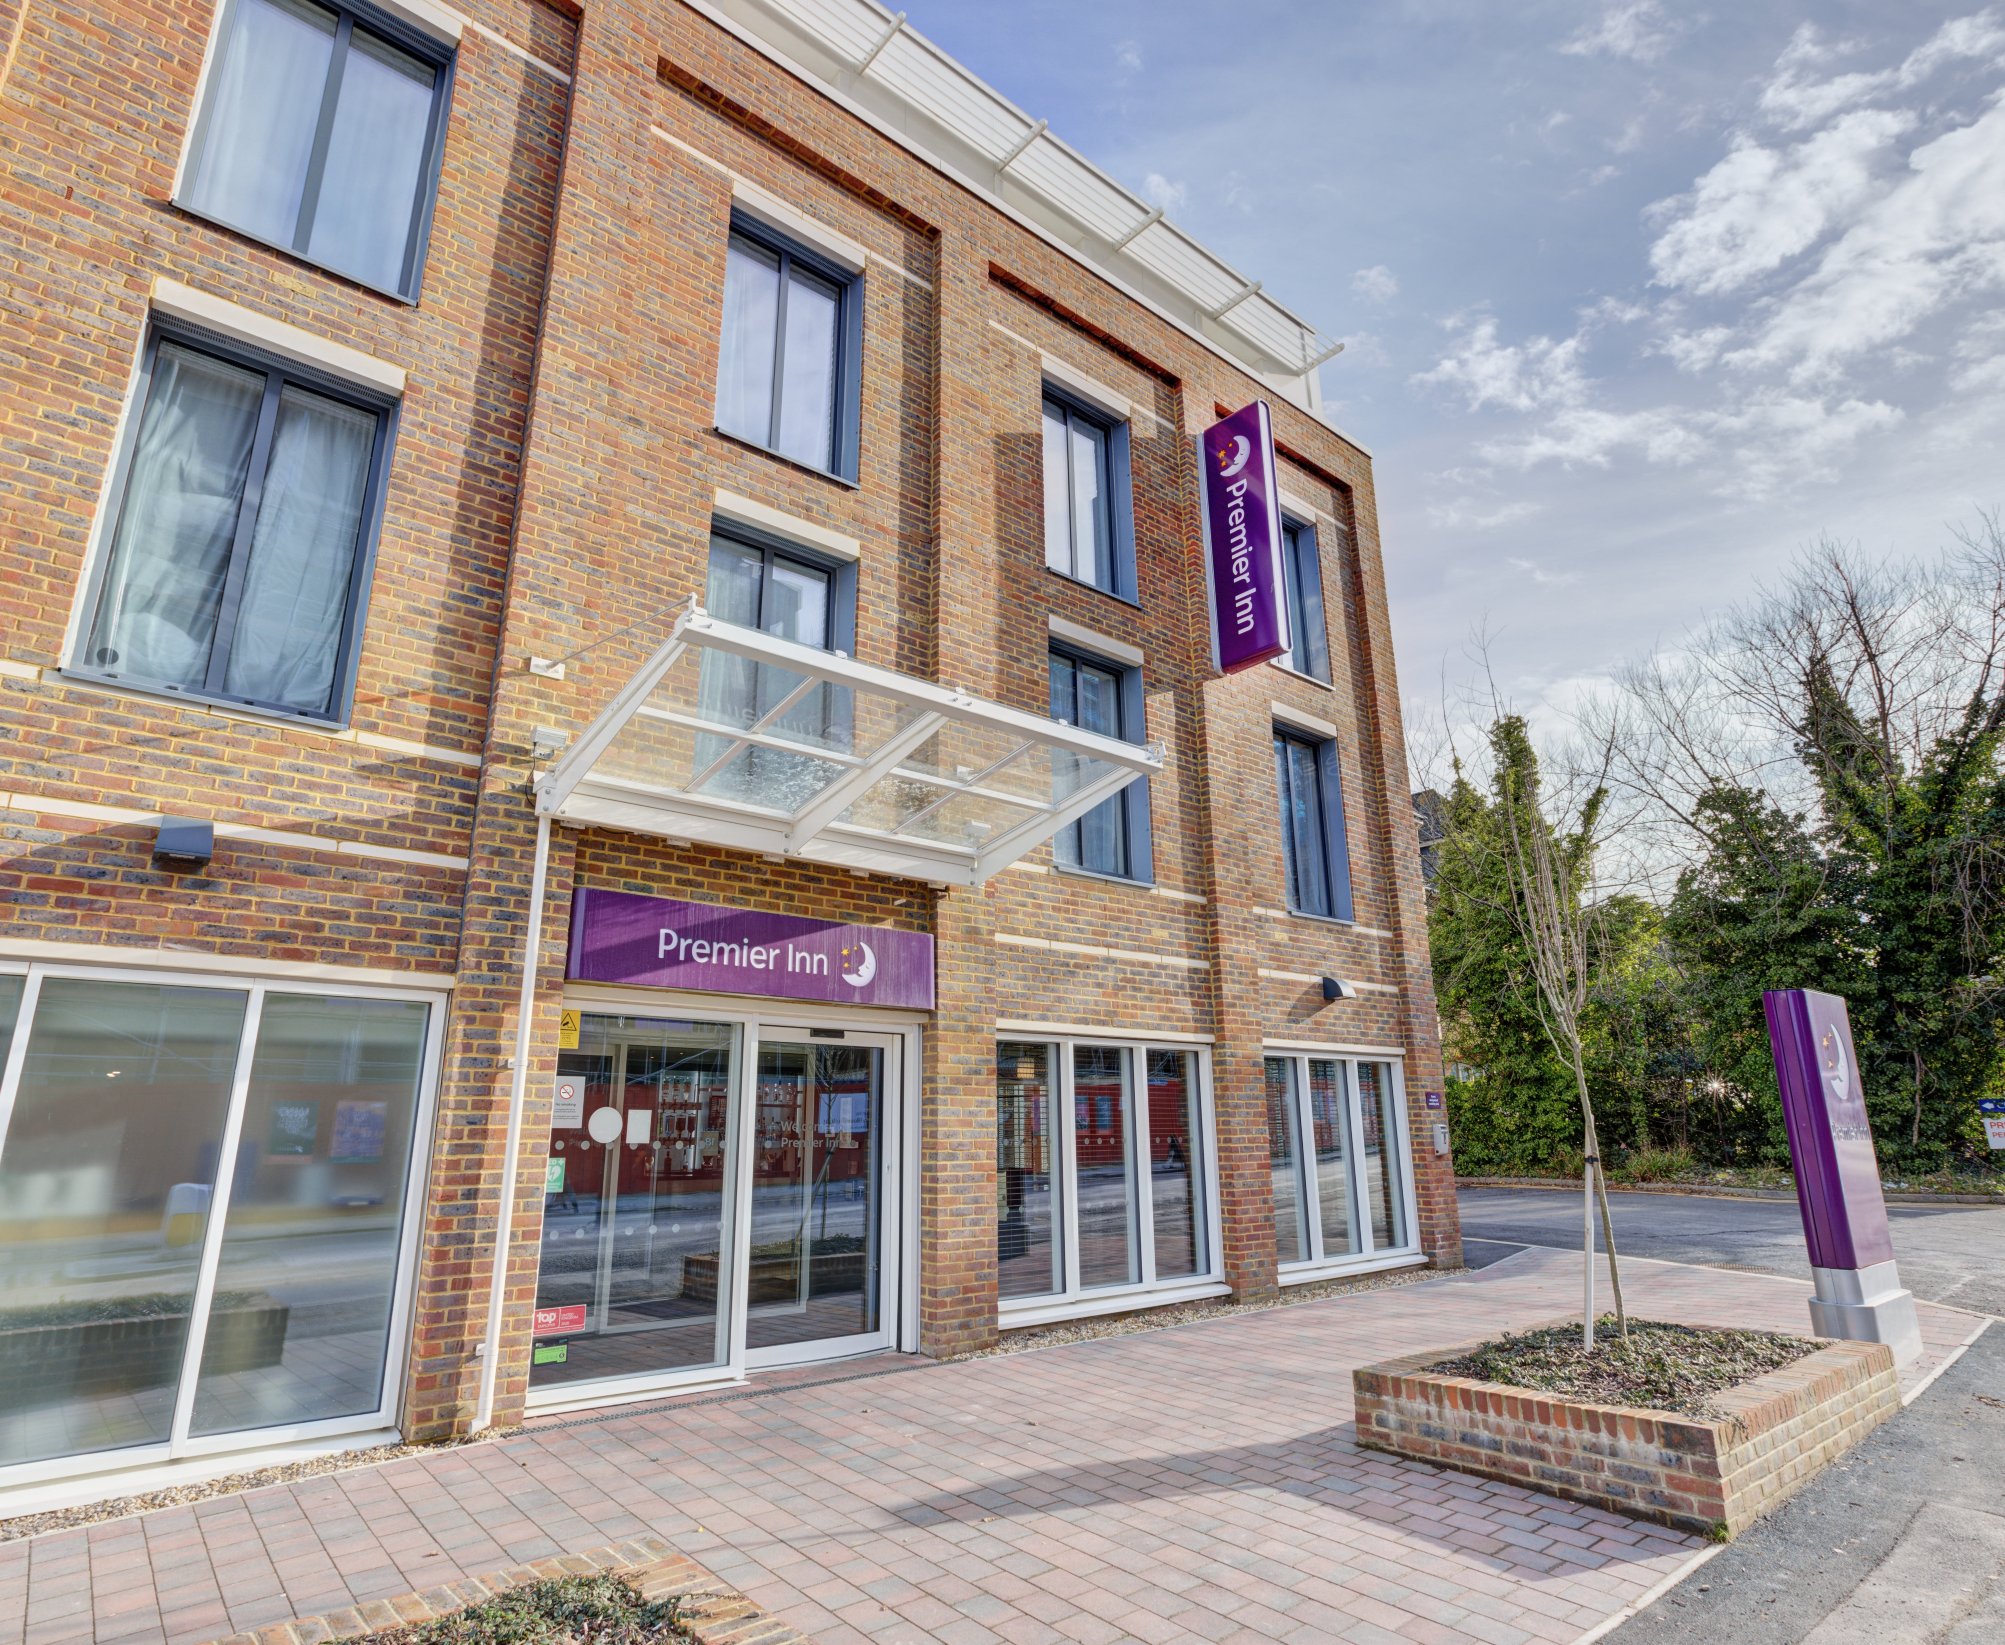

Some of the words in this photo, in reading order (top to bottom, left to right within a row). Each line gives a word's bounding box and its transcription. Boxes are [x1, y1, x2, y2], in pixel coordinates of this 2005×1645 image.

[1226, 478, 1253, 584] Premier
[1235, 587, 1257, 635] Inn
[658, 928, 781, 970] Premier
[787, 943, 828, 976] Inn
[537, 1311, 557, 1324] top
